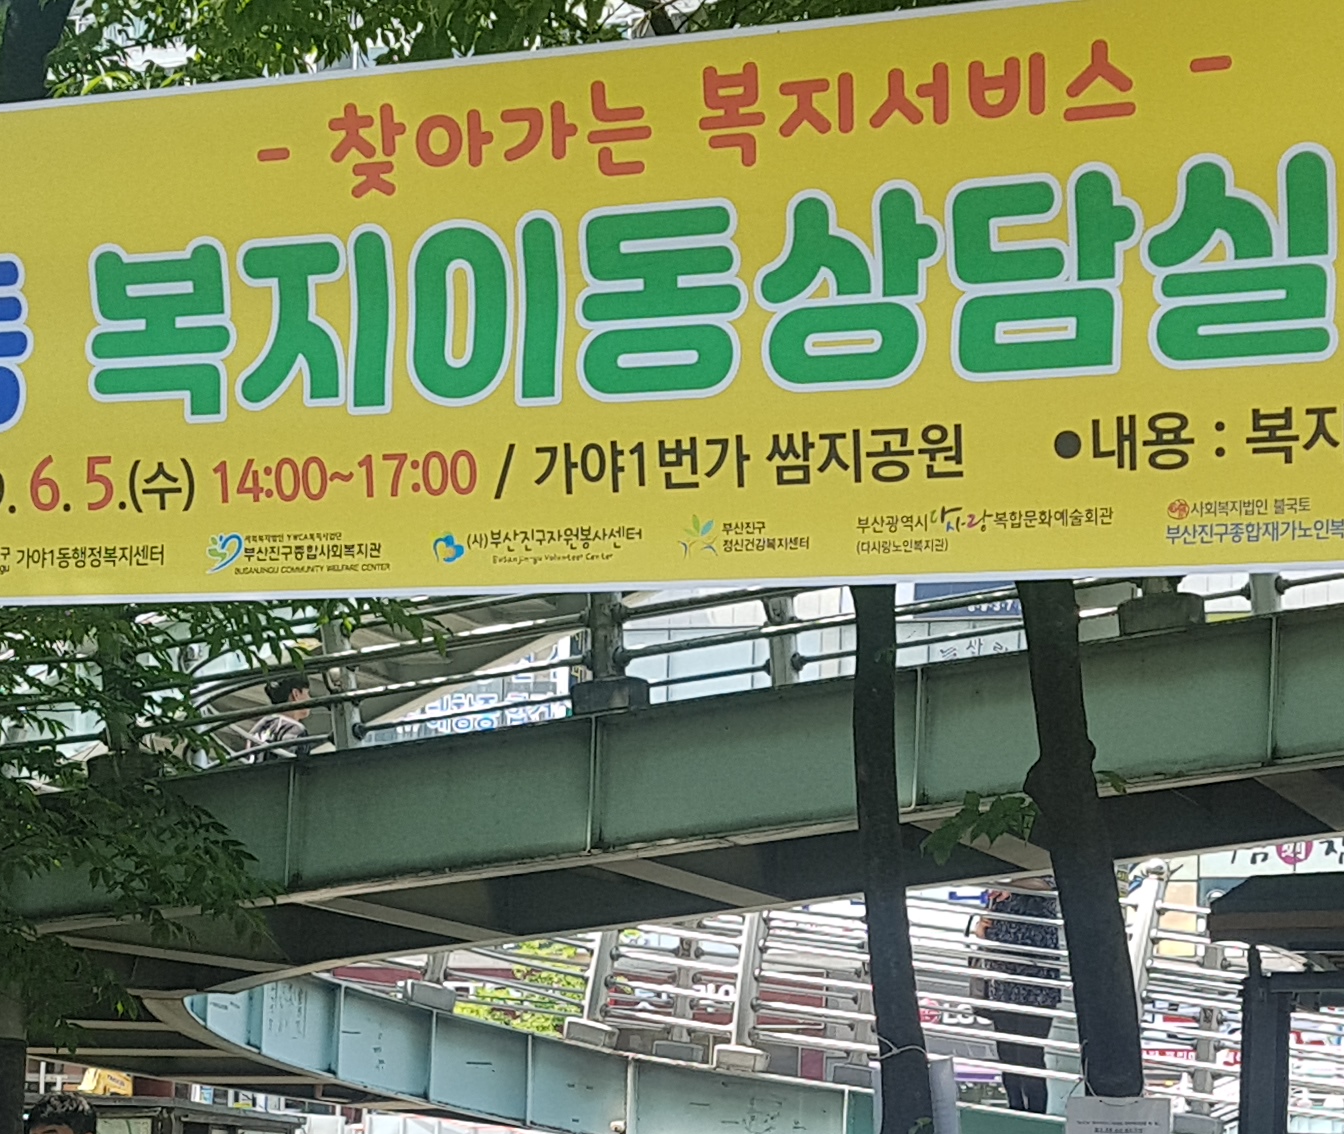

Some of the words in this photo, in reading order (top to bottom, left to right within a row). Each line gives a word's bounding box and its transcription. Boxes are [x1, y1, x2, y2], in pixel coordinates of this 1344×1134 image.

[329, 79, 653, 199] 찾아가는
[698, 38, 1137, 168] 복지서비스
[1088, 409, 1195, 473] 내용
[211, 449, 479, 509] 14:00~17:00
[534, 433, 749, 498] 가야1번가
[765, 422, 967, 488] 쌈지공원
[1190, 497, 1269, 518] 사회복지법인
[1273, 497, 1312, 516] 불국토
[466, 525, 644, 552] (사)부산진구자원봉사센터
[721, 521, 767, 536] 부산진구
[15, 544, 166, 570] 가야1동행정복지센터
[243, 541, 383, 563] 부산진구종합사회복지관
[722, 536, 810, 554] 정신건강복지센터
